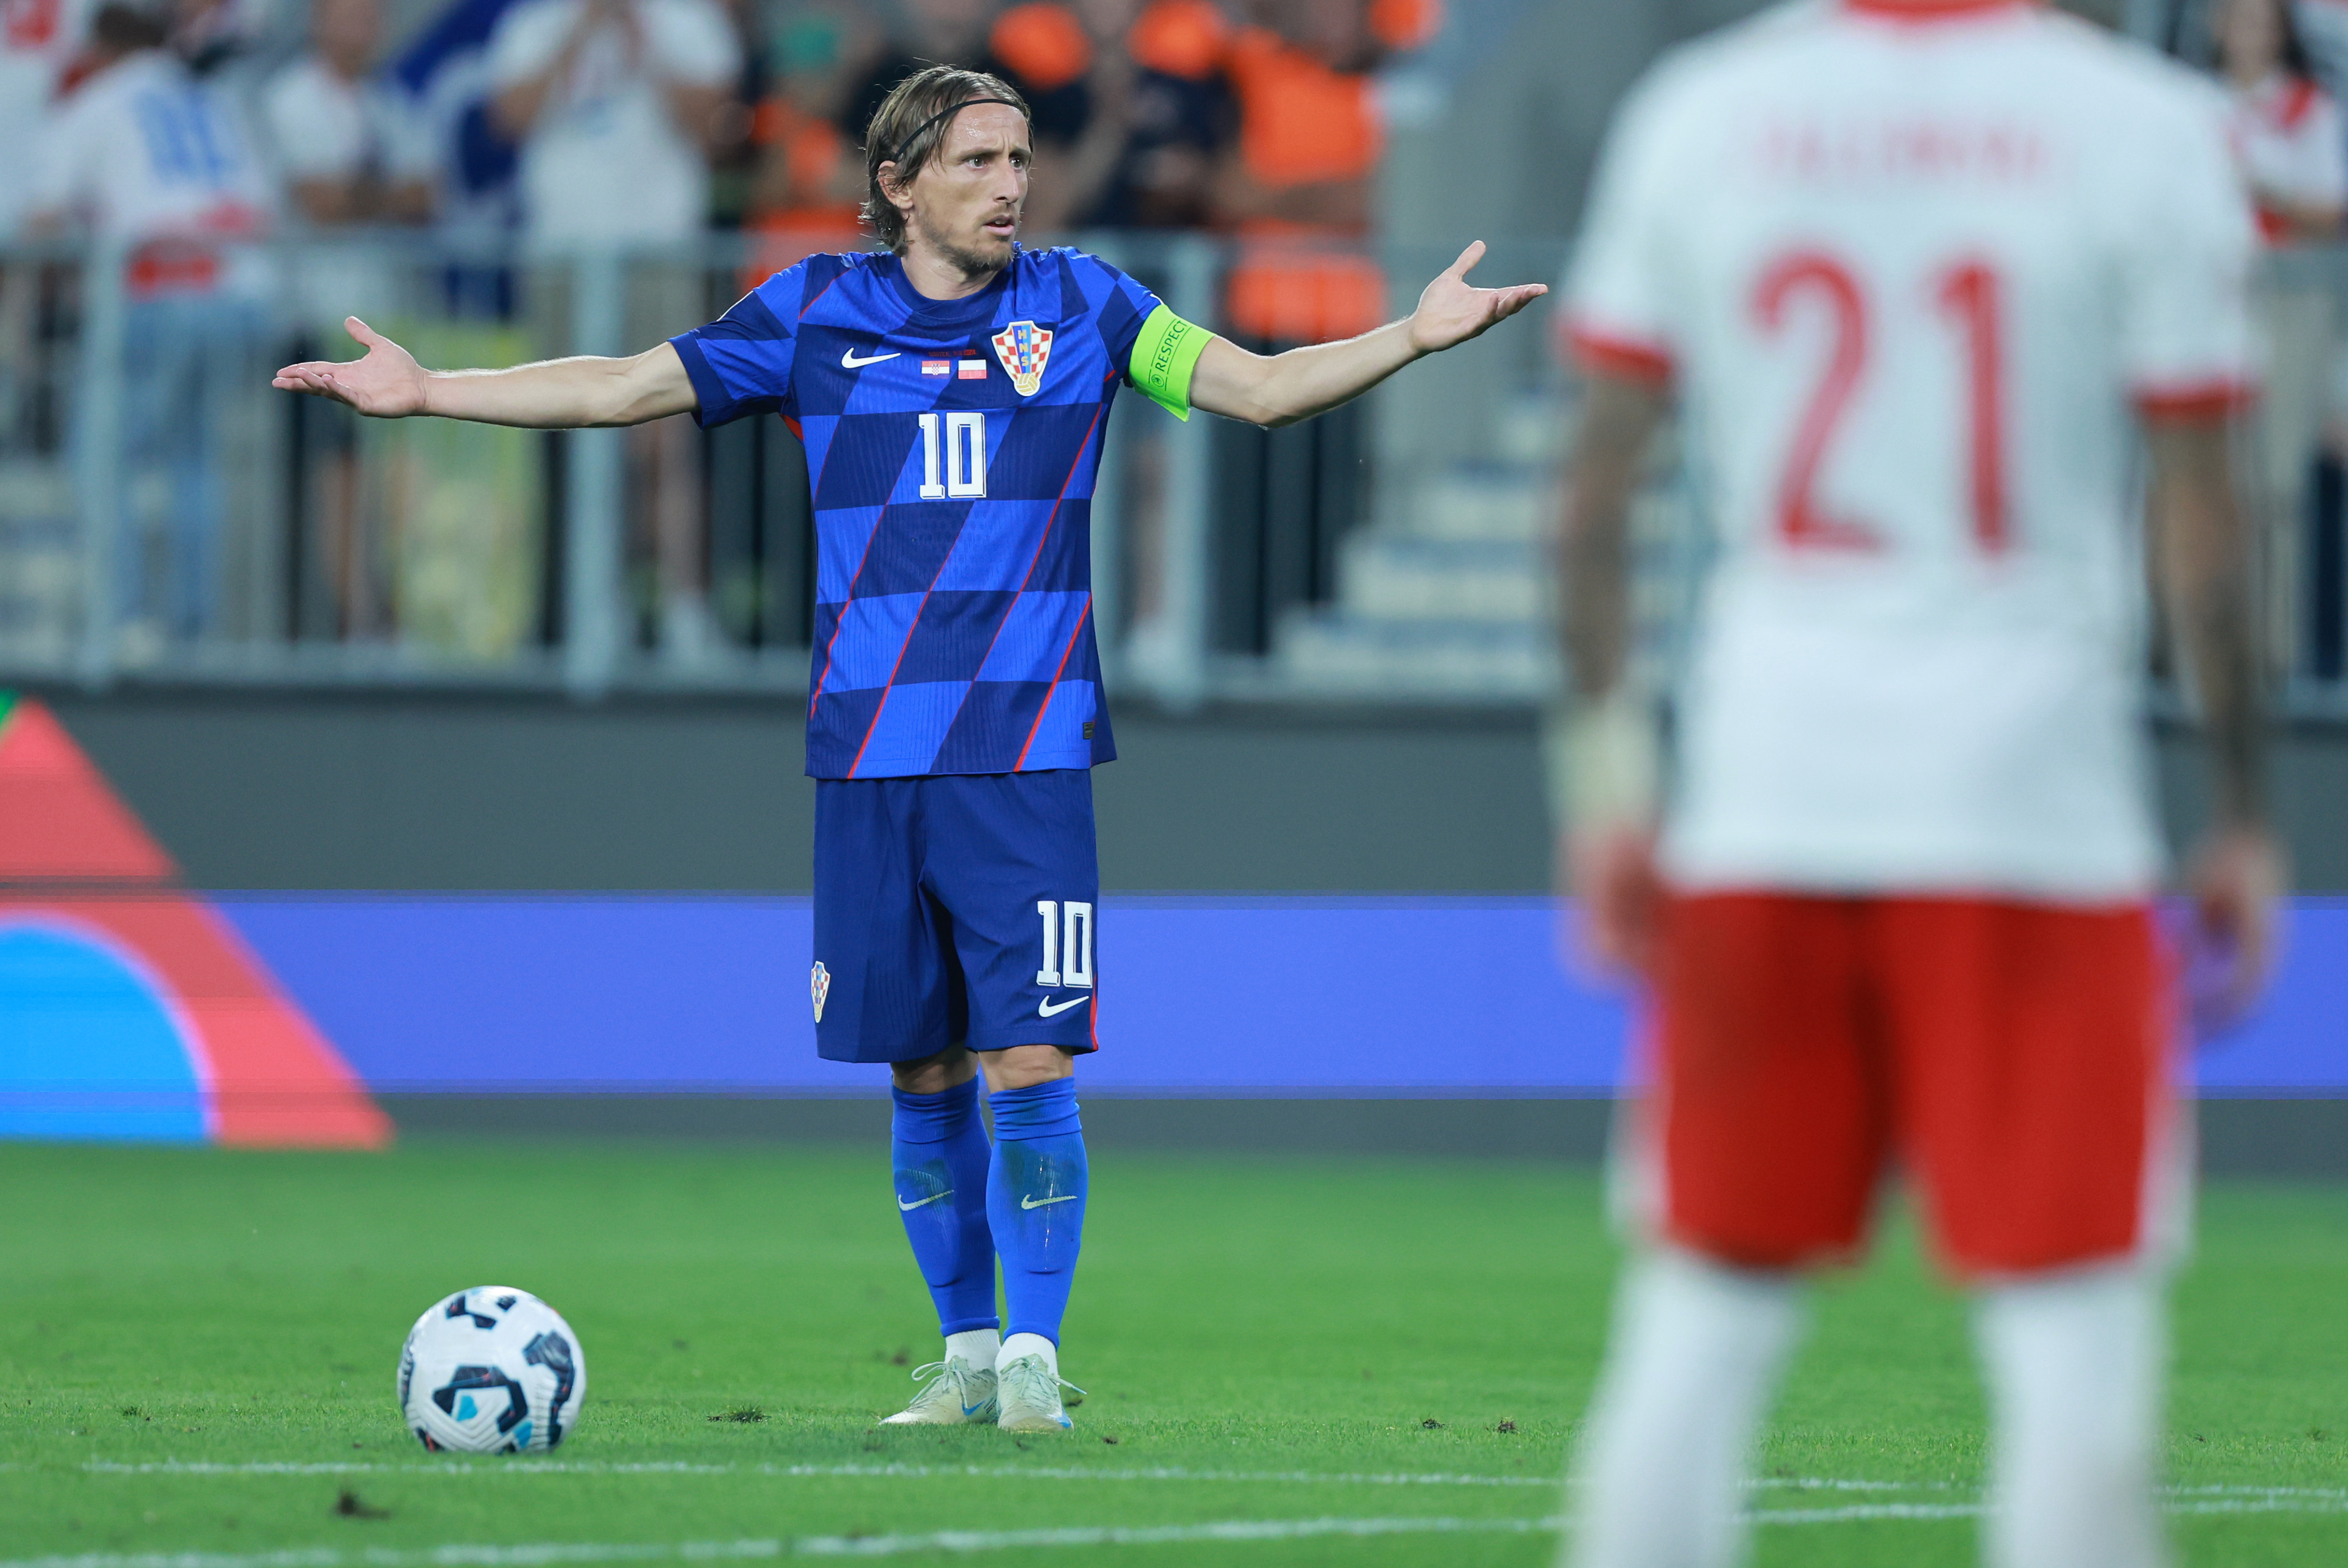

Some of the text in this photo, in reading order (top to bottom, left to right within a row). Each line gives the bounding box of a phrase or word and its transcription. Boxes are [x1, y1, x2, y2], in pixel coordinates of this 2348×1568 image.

[1017, 329, 1029, 367] HNS
[1155, 320, 1188, 372] RESPECT
[1750, 243, 2007, 554] 21
[918, 412, 986, 499] 10
[1036, 900, 1093, 989] 10
